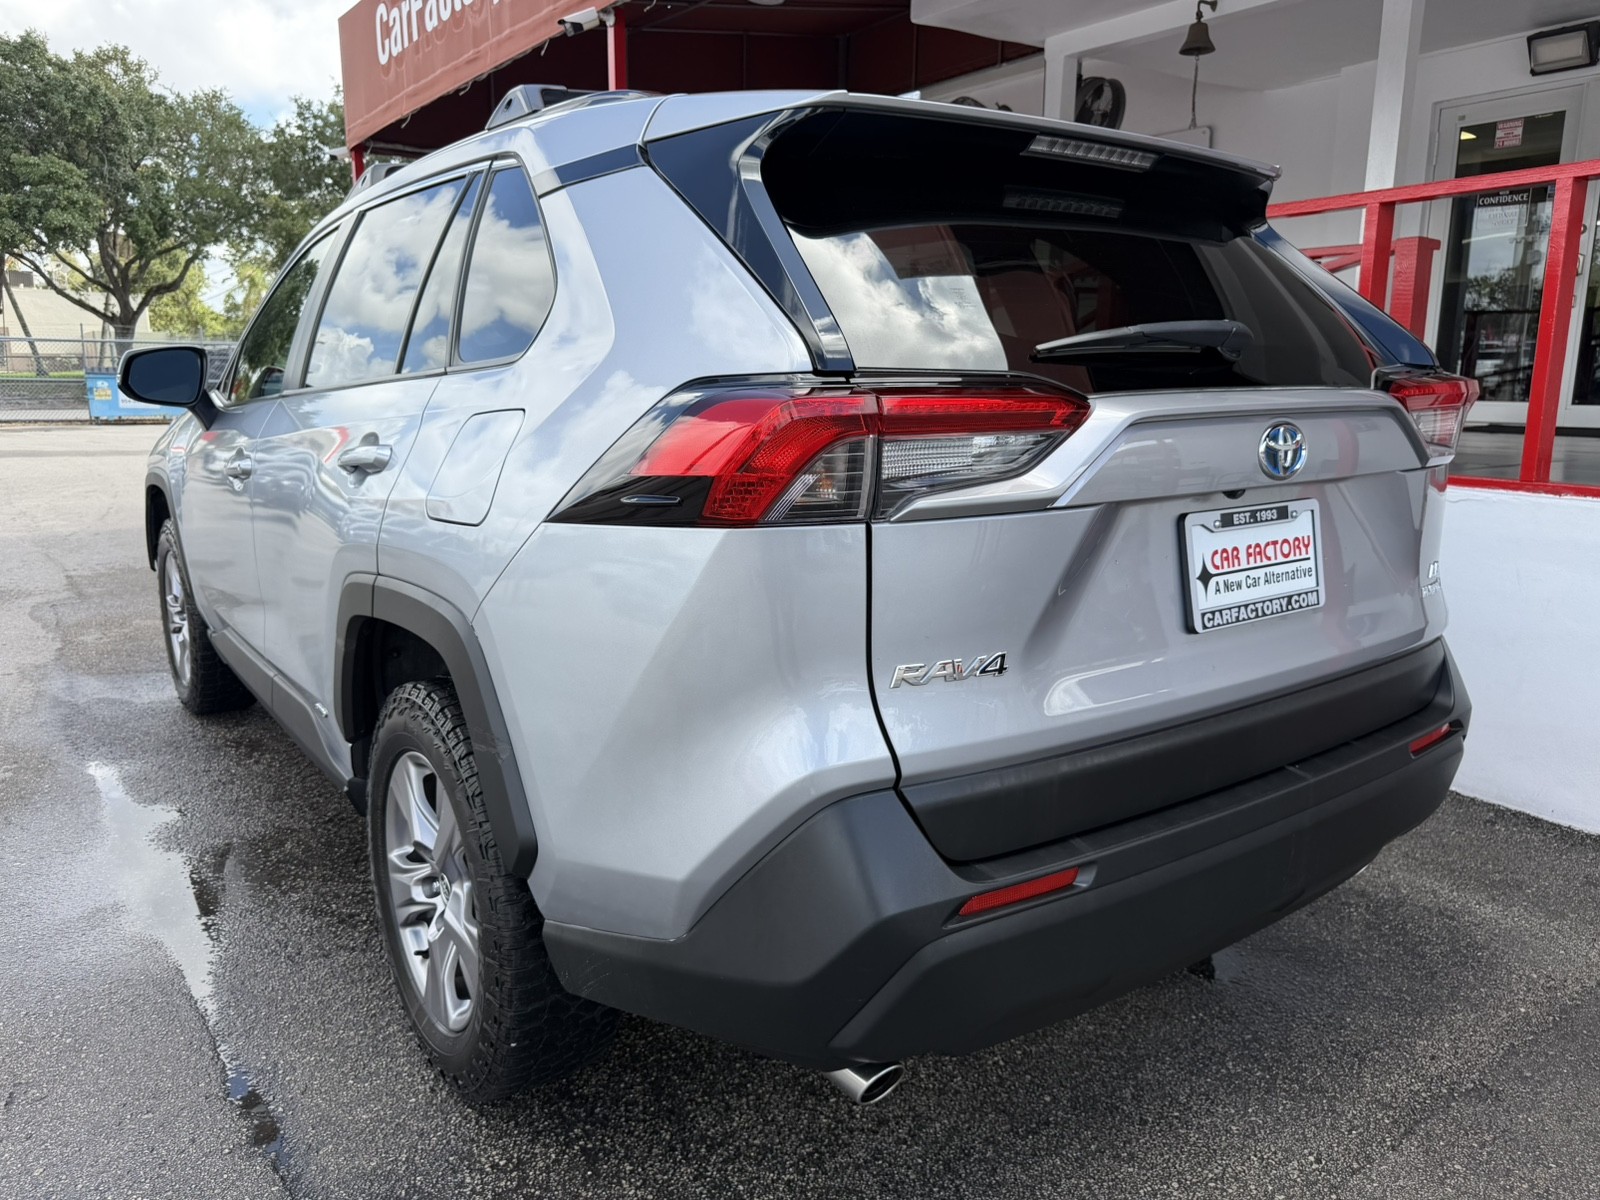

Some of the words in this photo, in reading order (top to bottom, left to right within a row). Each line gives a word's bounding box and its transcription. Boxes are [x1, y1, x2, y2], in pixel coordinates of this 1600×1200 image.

[1479, 192, 1529, 206] CONFIDENCE
[1233, 513, 1254, 525] EST.
[1256, 509, 1277, 522] 1993
[1211, 546, 1241, 571] CAR
[1246, 535, 1311, 565] FACTORY
[1214, 581, 1222, 595] A
[1223, 578, 1243, 593] New
[1245, 575, 1261, 589] Car
[1263, 565, 1313, 585] Alternative
[1203, 591, 1318, 628] CARFACTORY.COM
[889, 651, 1008, 689] RAV4
